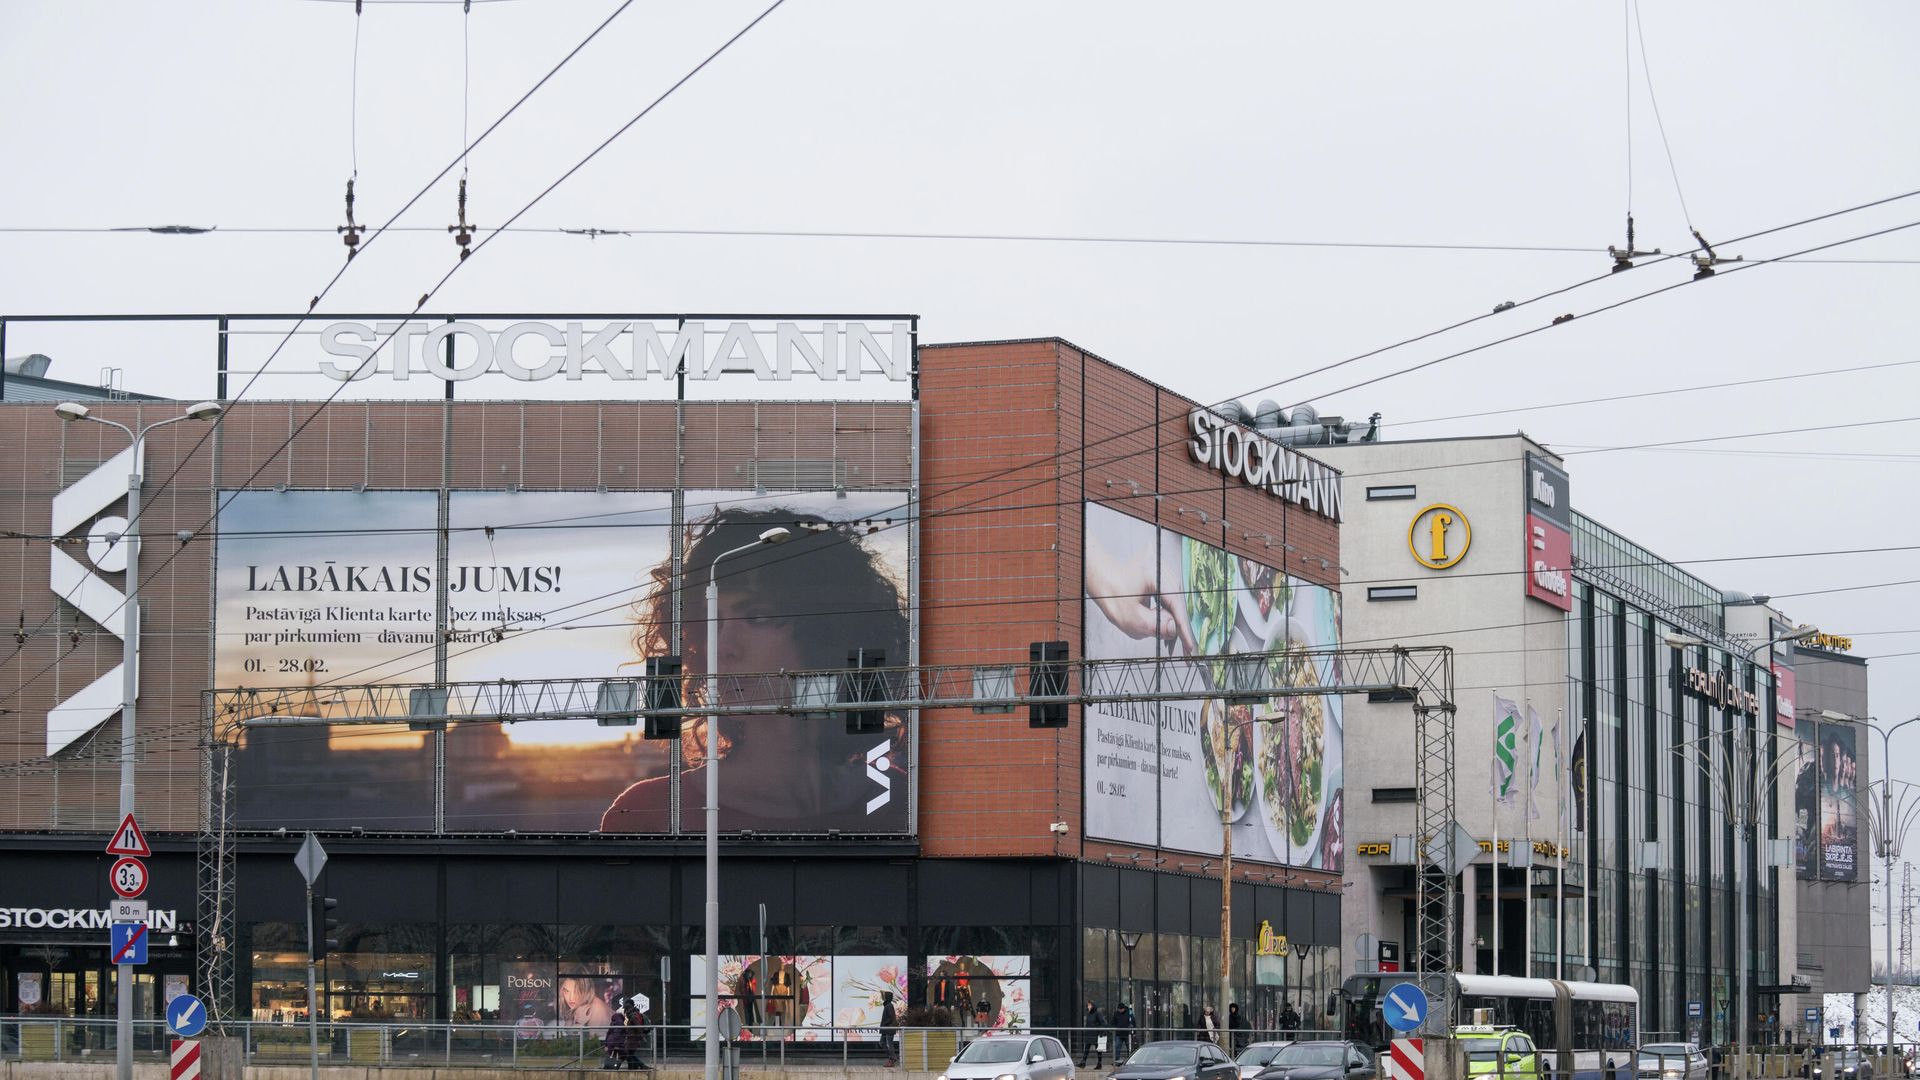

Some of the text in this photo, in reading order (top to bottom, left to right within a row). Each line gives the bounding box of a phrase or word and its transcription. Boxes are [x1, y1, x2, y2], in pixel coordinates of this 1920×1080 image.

[318, 322, 907, 381] STOCKMANN
[1188, 406, 1344, 524] STOCKMANN
[1533, 470, 1555, 508] Kino
[246, 561, 562, 593] LABĀKAIS JUMS!
[246, 606, 321, 624] Pastāvīgā
[325, 606, 384, 622] Klienta
[388, 606, 432, 622] karte
[451, 607, 477, 621] bez
[244, 632, 272, 646] par
[274, 629, 361, 646] pirkumiem
[377, 629, 434, 644] dāvanu
[452, 631, 496, 643] karte
[279, 658, 329, 673] 28.02.
[1727, 684, 1759, 716] CINMAS
[1161, 705, 1197, 737] JUMS!
[1357, 844, 1391, 855] FOR
[0, 908, 176, 929] STOCKMNN
[120, 906, 130, 916] 80
